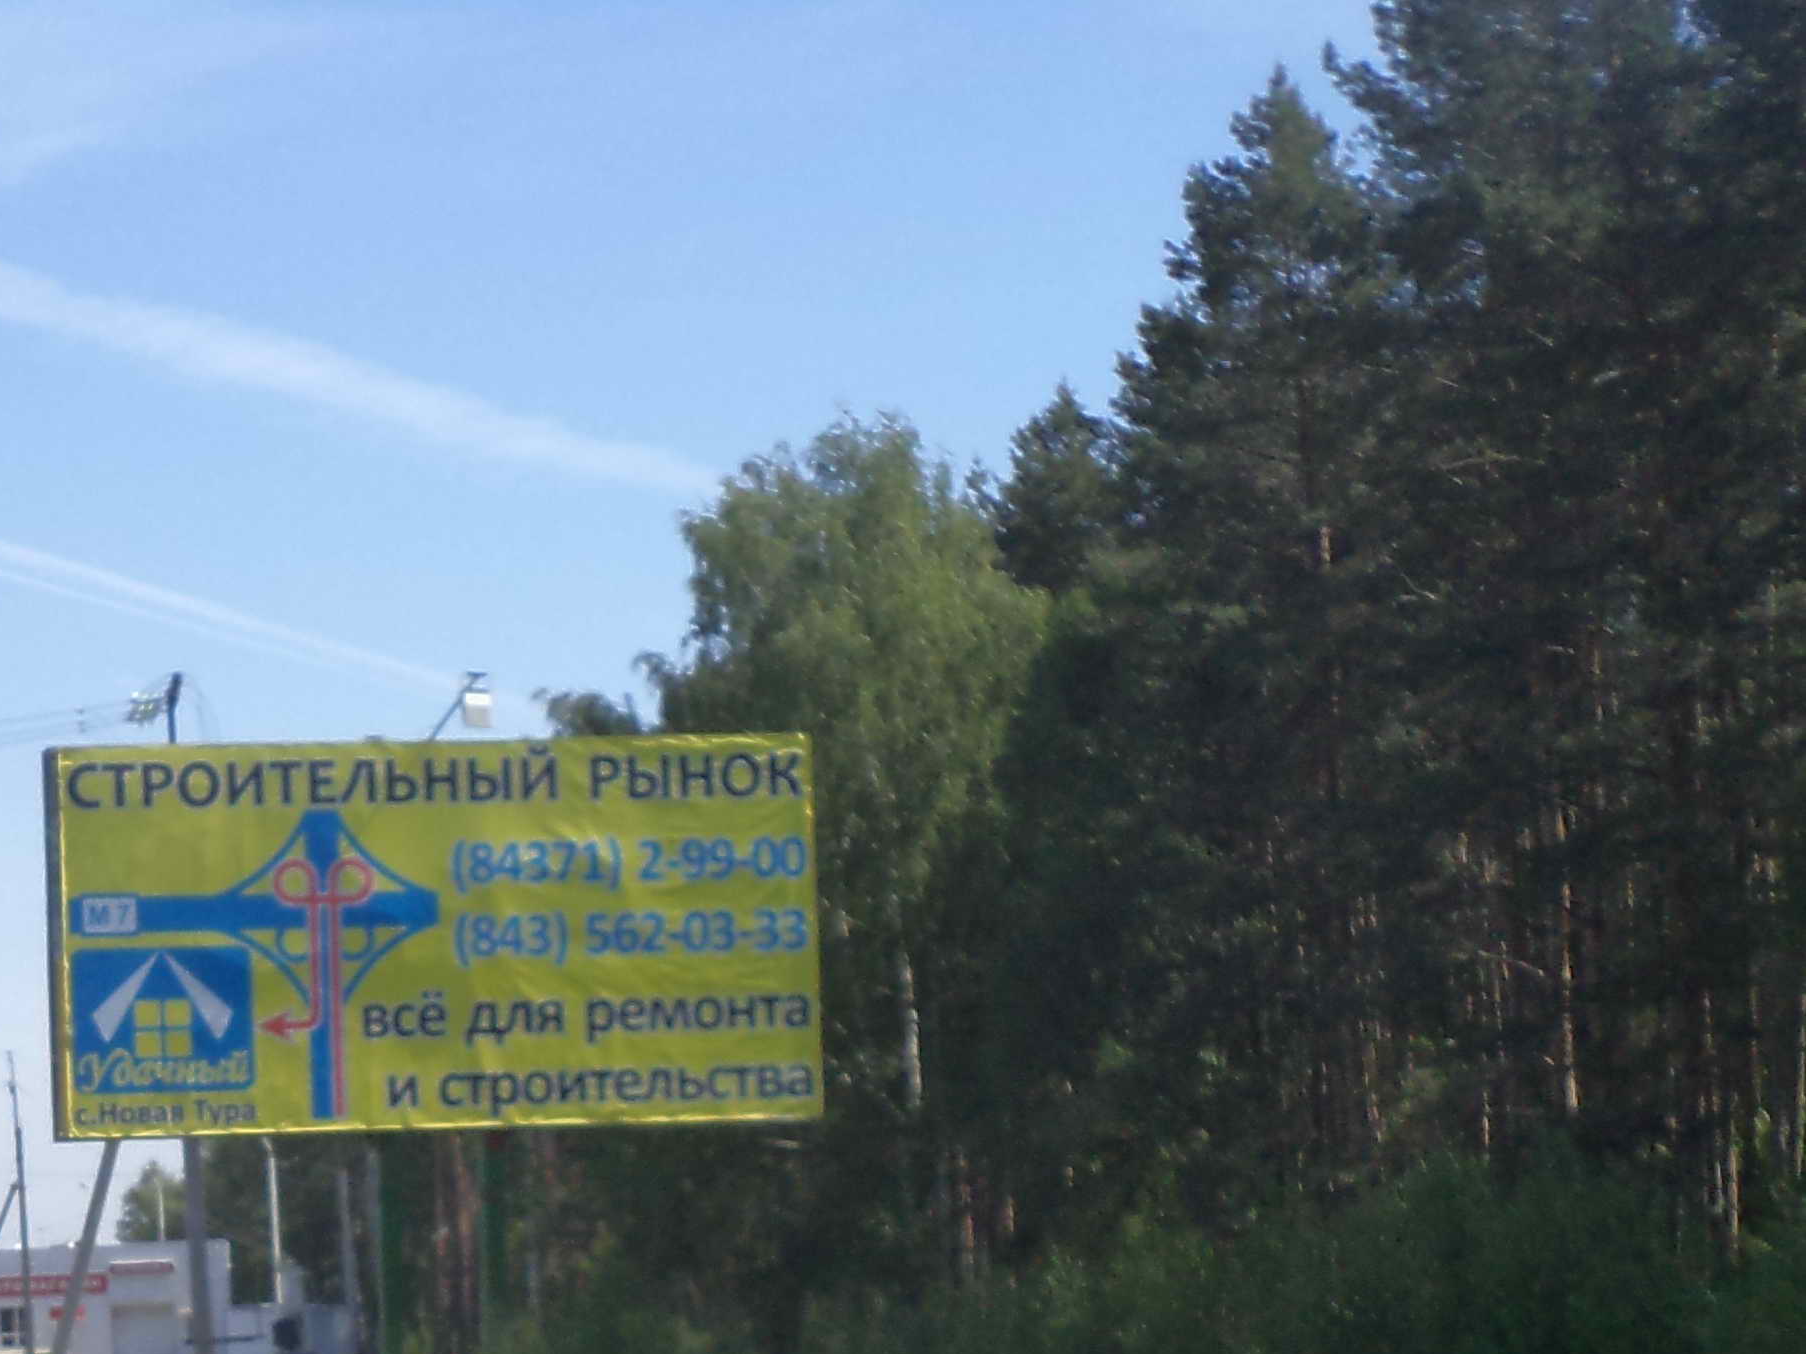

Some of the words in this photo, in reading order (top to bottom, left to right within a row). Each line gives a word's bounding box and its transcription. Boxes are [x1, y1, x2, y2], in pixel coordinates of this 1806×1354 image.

[67, 744, 558, 809] СТРОИТЕЛЬНЫЙ
[589, 752, 802, 800] РЫНОК
[451, 836, 623, 893] (84371)
[638, 836, 807, 882] 2-99-00
[454, 911, 569, 969] (843)
[585, 908, 808, 955] 562-03-33
[363, 992, 446, 1038] всё
[466, 999, 564, 1046] для
[587, 993, 810, 1041] ремонта
[195, 1099, 257, 1126] Тура
[388, 1073, 419, 1106] и
[438, 1062, 813, 1115] строительства
